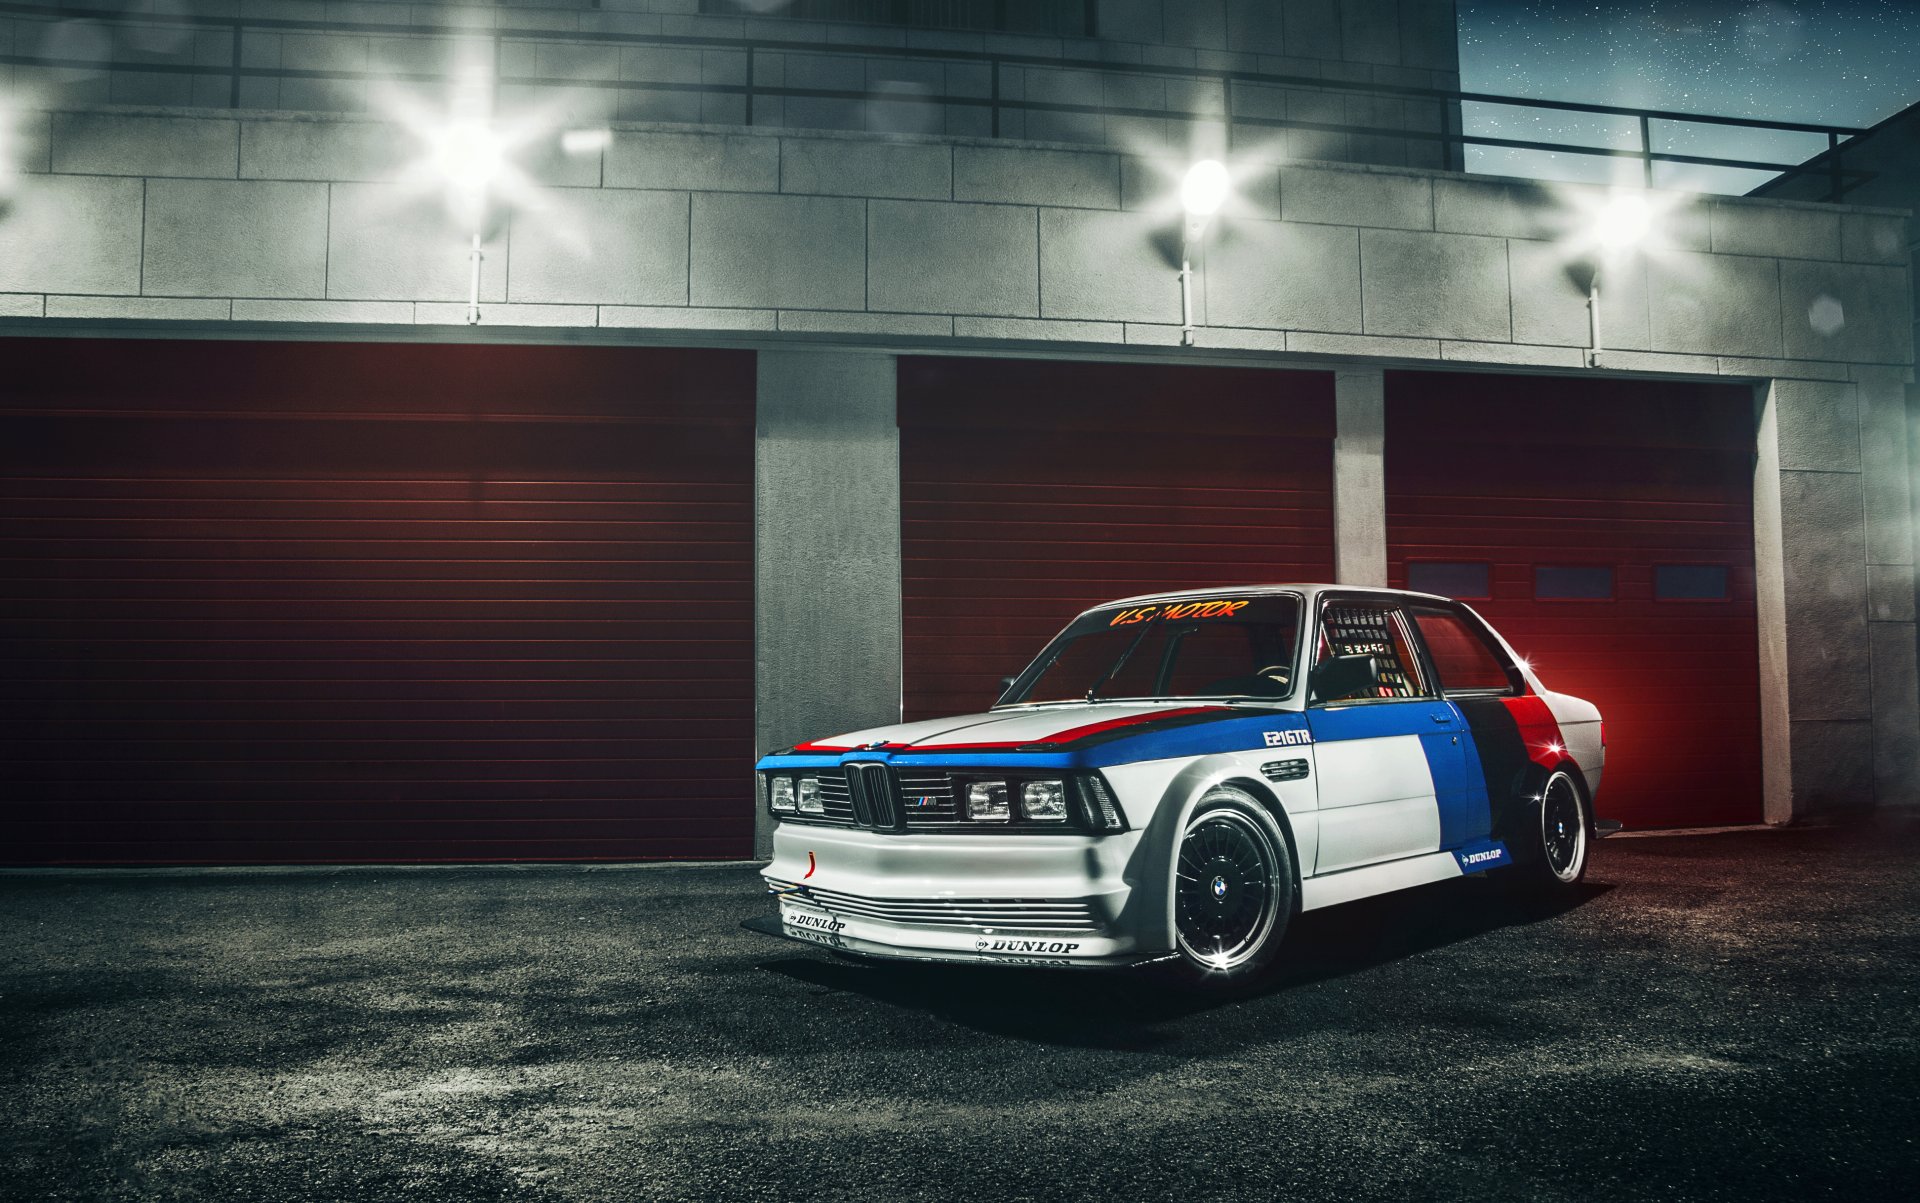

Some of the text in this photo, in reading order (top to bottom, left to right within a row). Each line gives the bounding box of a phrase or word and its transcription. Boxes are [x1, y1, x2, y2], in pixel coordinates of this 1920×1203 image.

[1469, 848, 1502, 864] DUNLOP
[797, 914, 846, 932] DUNLOP
[990, 940, 1080, 954] DUNLOP
